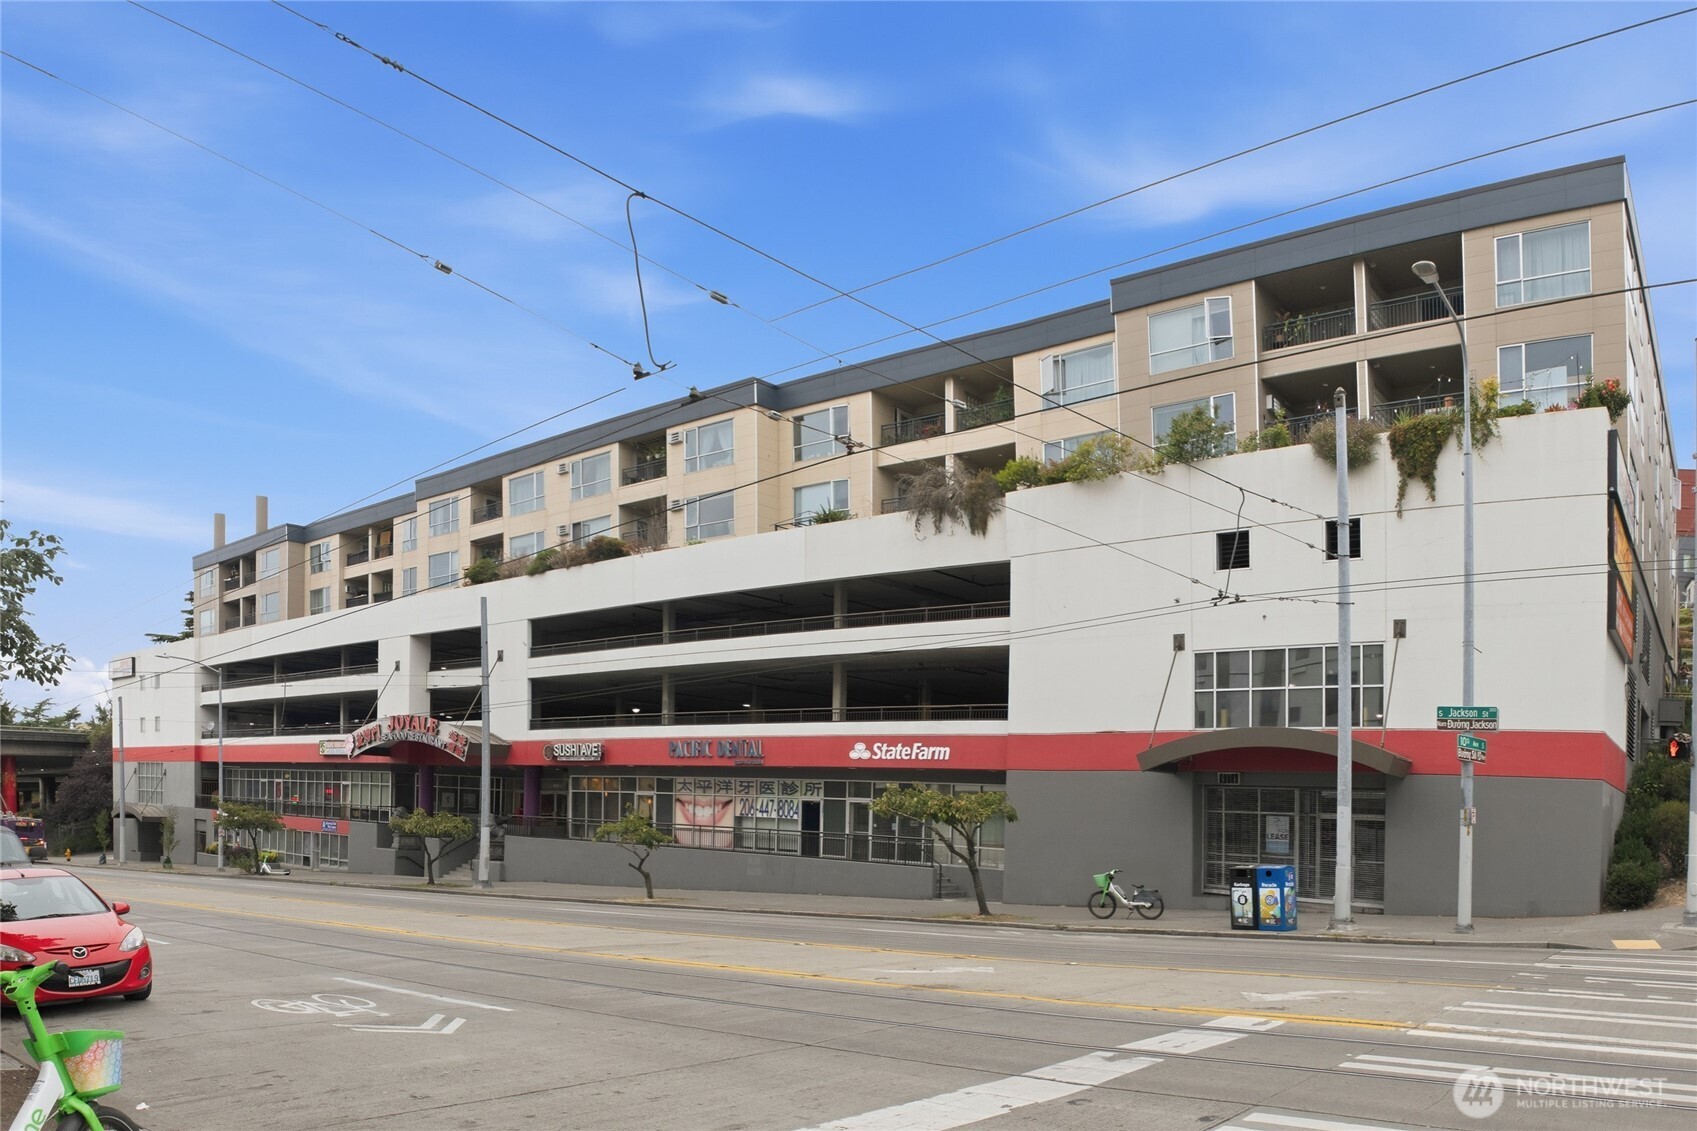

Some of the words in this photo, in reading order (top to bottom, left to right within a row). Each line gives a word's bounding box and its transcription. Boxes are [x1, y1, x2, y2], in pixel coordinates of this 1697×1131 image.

[1448, 708, 1478, 717] Jackson
[387, 715, 438, 735] JOYALE
[1470, 720, 1497, 730] Jackson
[553, 743, 581, 756] SUSHI
[669, 739, 713, 758] PACIFIC
[717, 739, 765, 758] DENTAL
[739, 798, 799, 818] 206-447-8084
